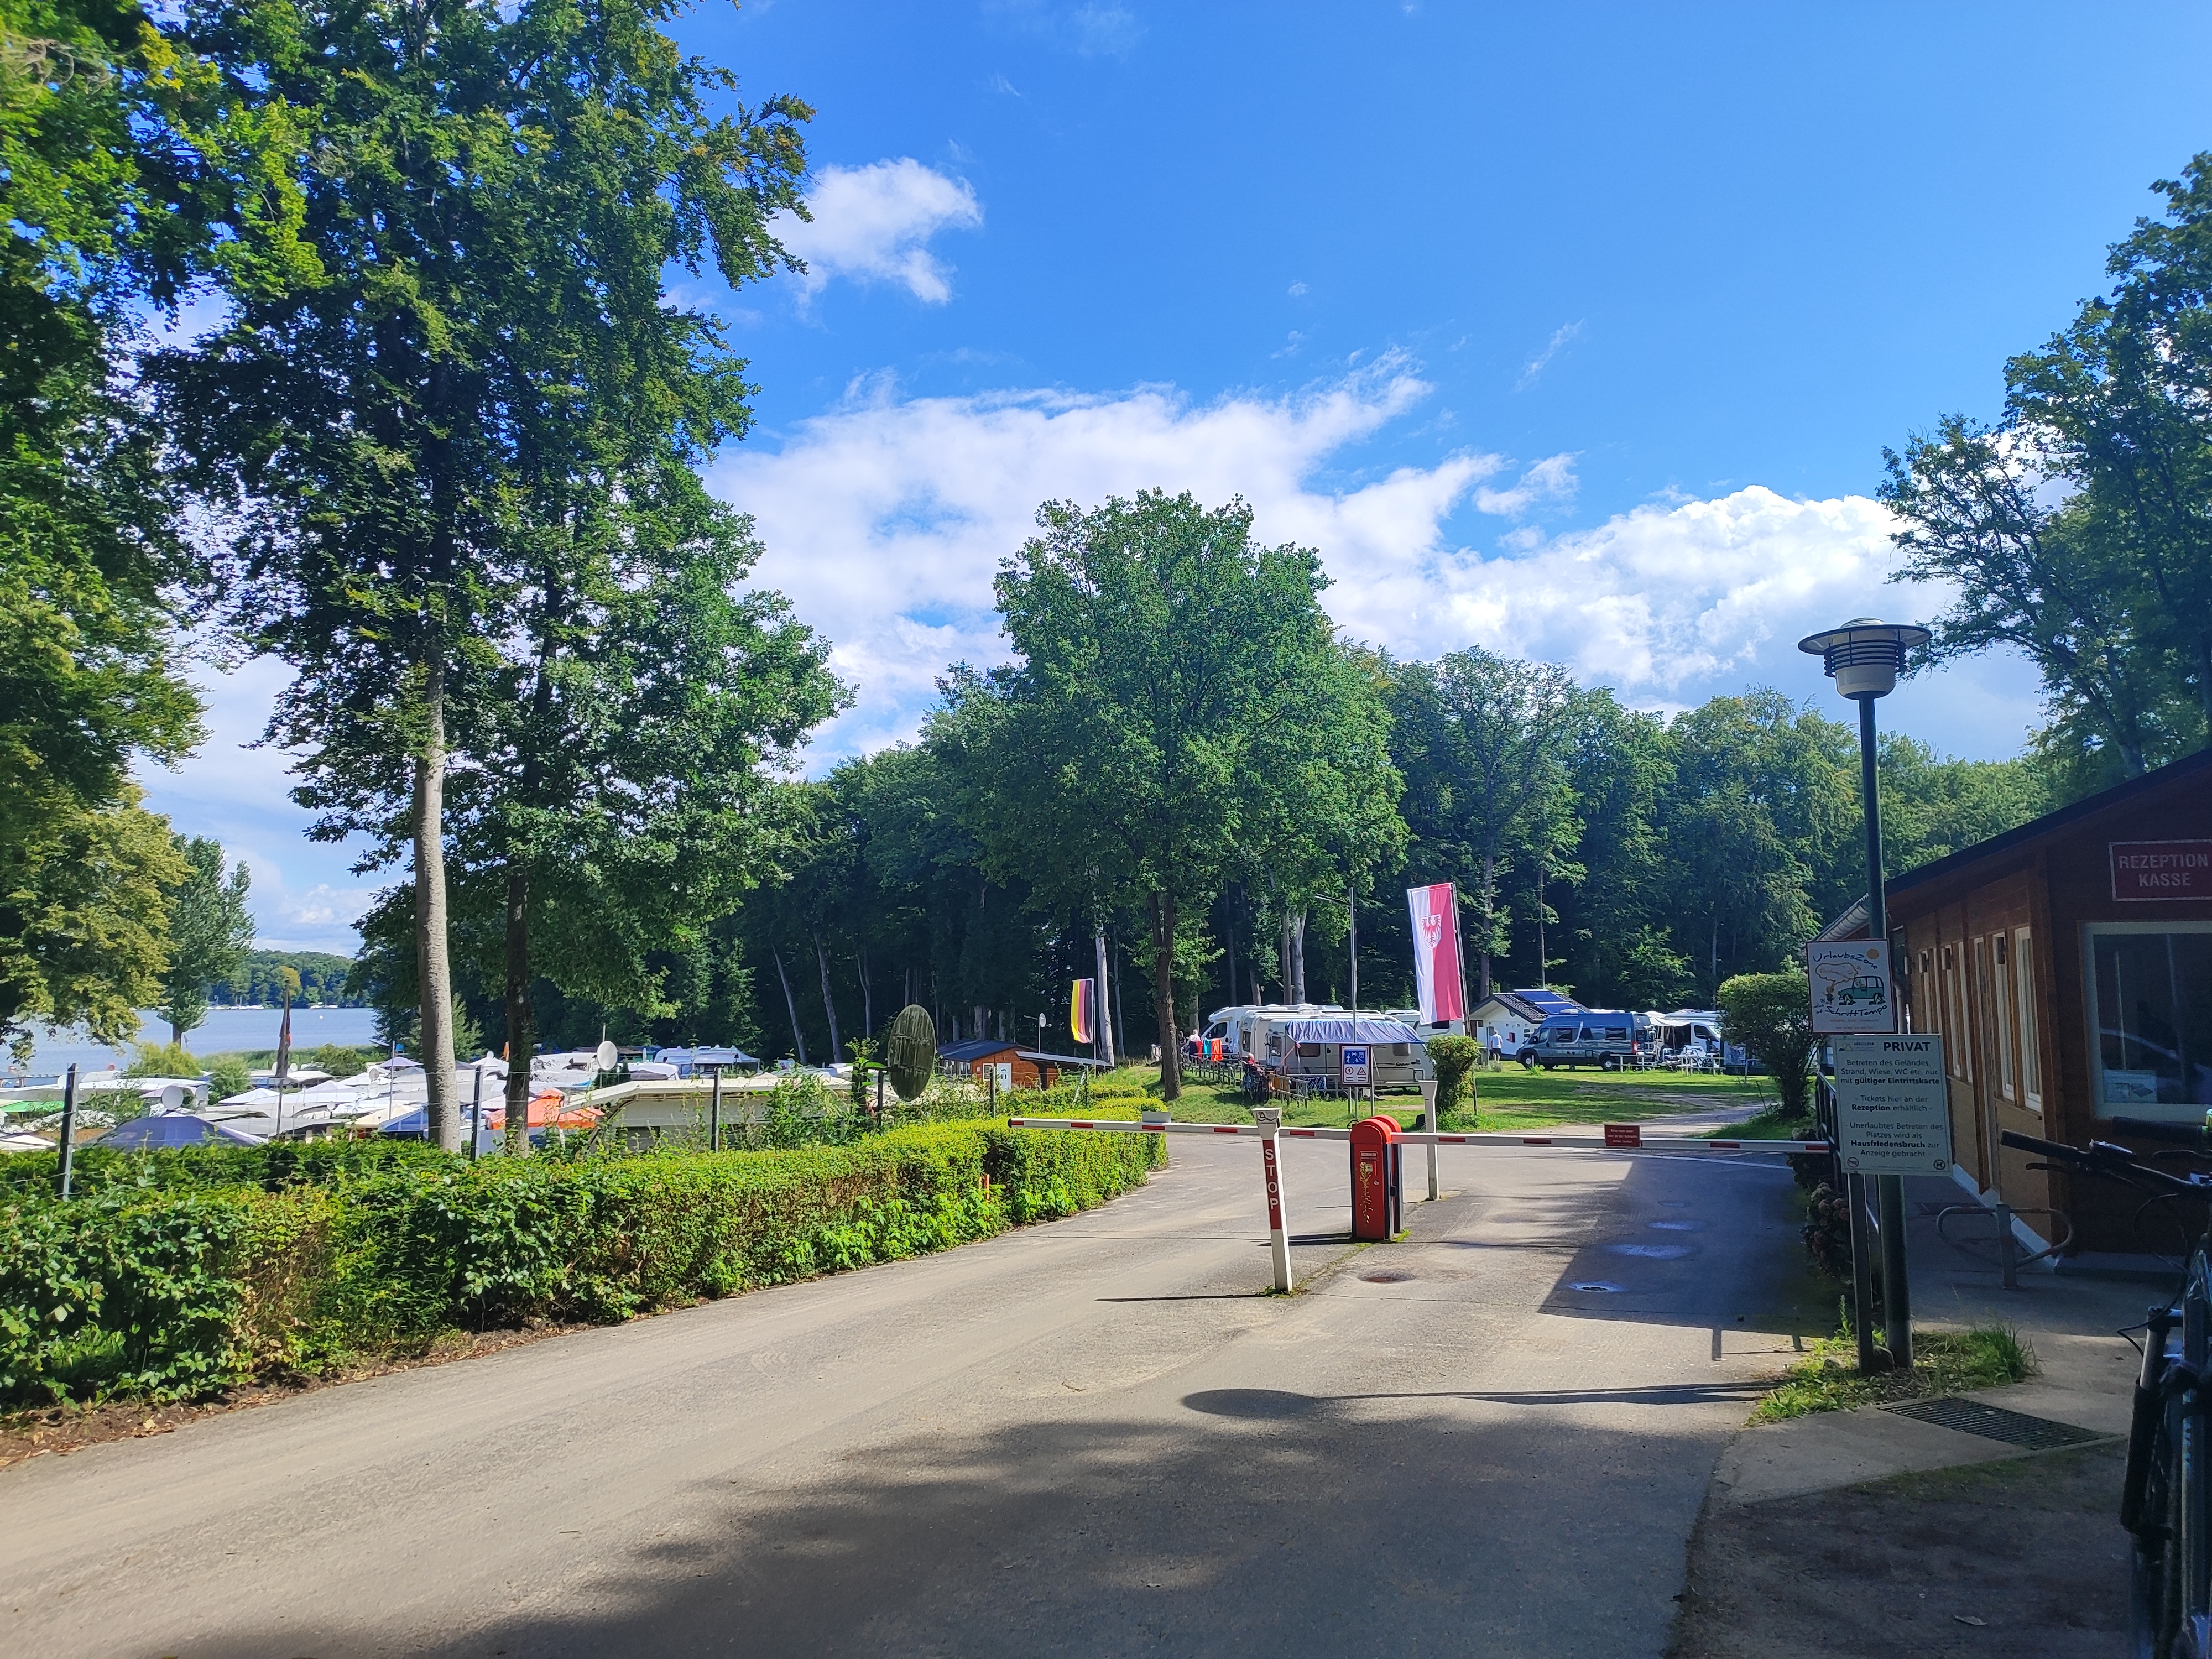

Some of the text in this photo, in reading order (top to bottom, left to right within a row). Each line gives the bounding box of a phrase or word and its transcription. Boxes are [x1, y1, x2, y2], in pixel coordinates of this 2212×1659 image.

[2119, 853, 2208, 868] REZEPTION
[2139, 873, 2191, 886] KASSE
[1883, 1042, 1931, 1052] PRIVAT
[1851, 1140, 1926, 1148] Hausfriedensbruch
[1265, 1148, 1279, 1210] STOP
